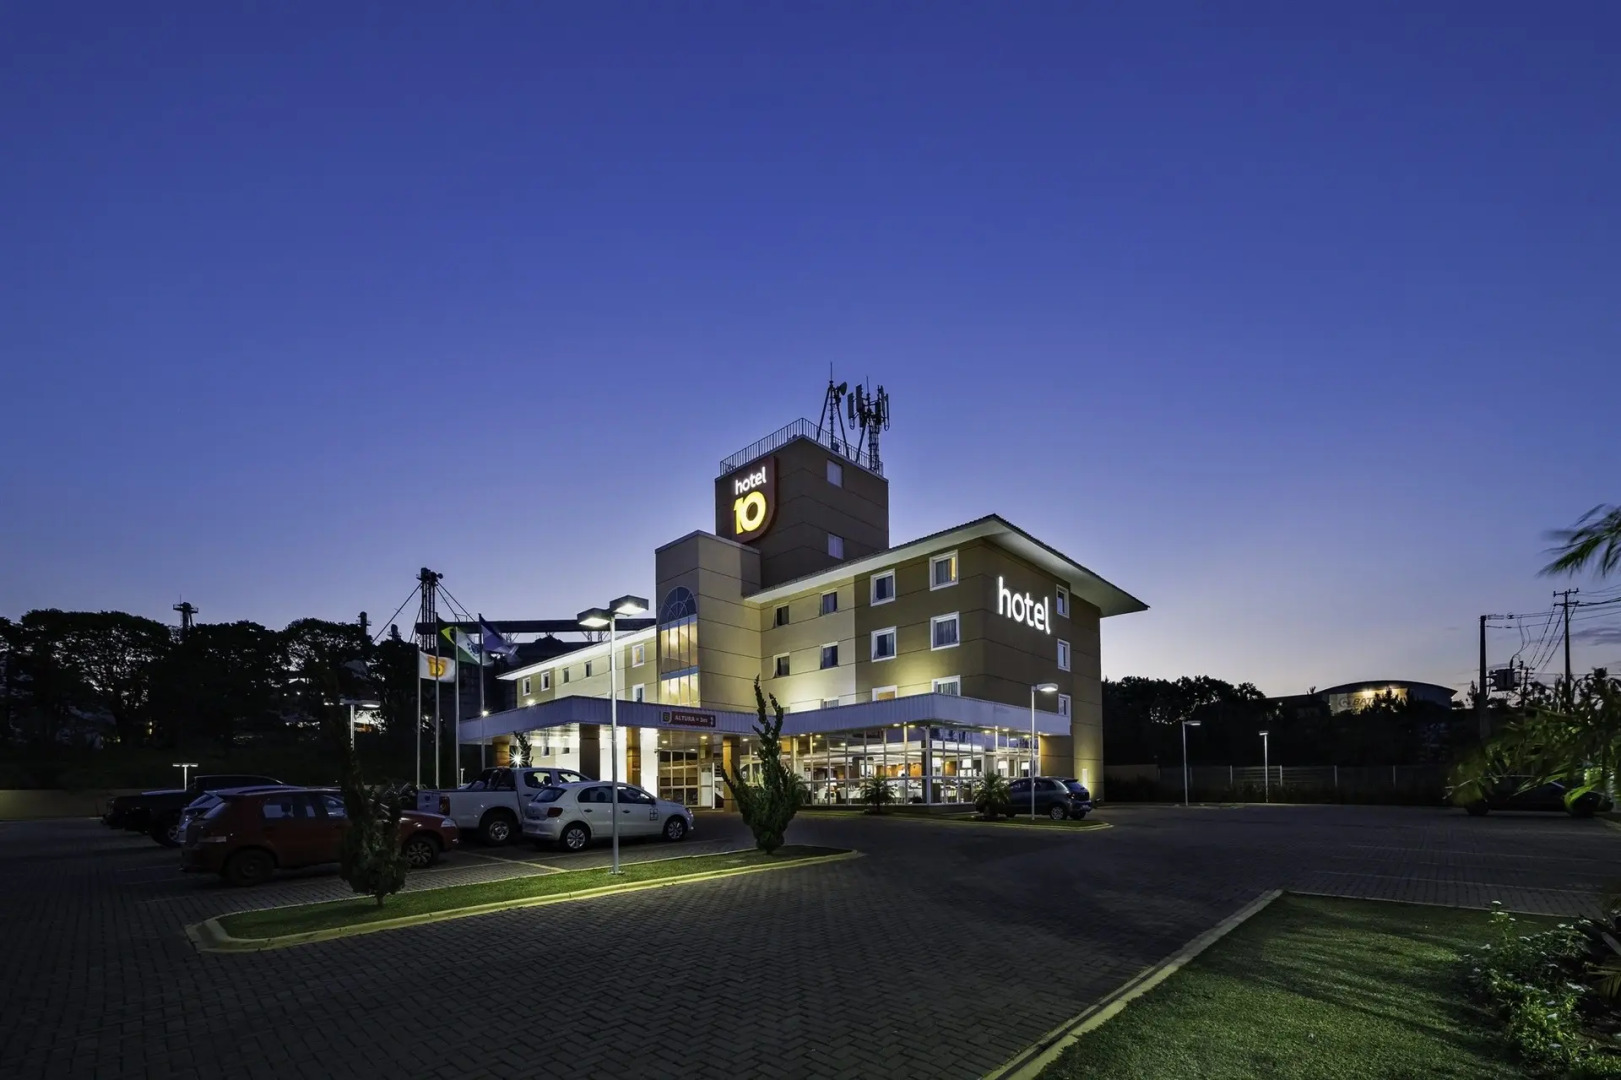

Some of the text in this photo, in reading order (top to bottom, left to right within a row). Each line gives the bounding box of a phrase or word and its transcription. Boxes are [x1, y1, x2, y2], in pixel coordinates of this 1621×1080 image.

[735, 466, 767, 495] hotel
[733, 491, 766, 535] 10
[998, 575, 1051, 635] hotel
[674, 714, 695, 722] ALTURA
